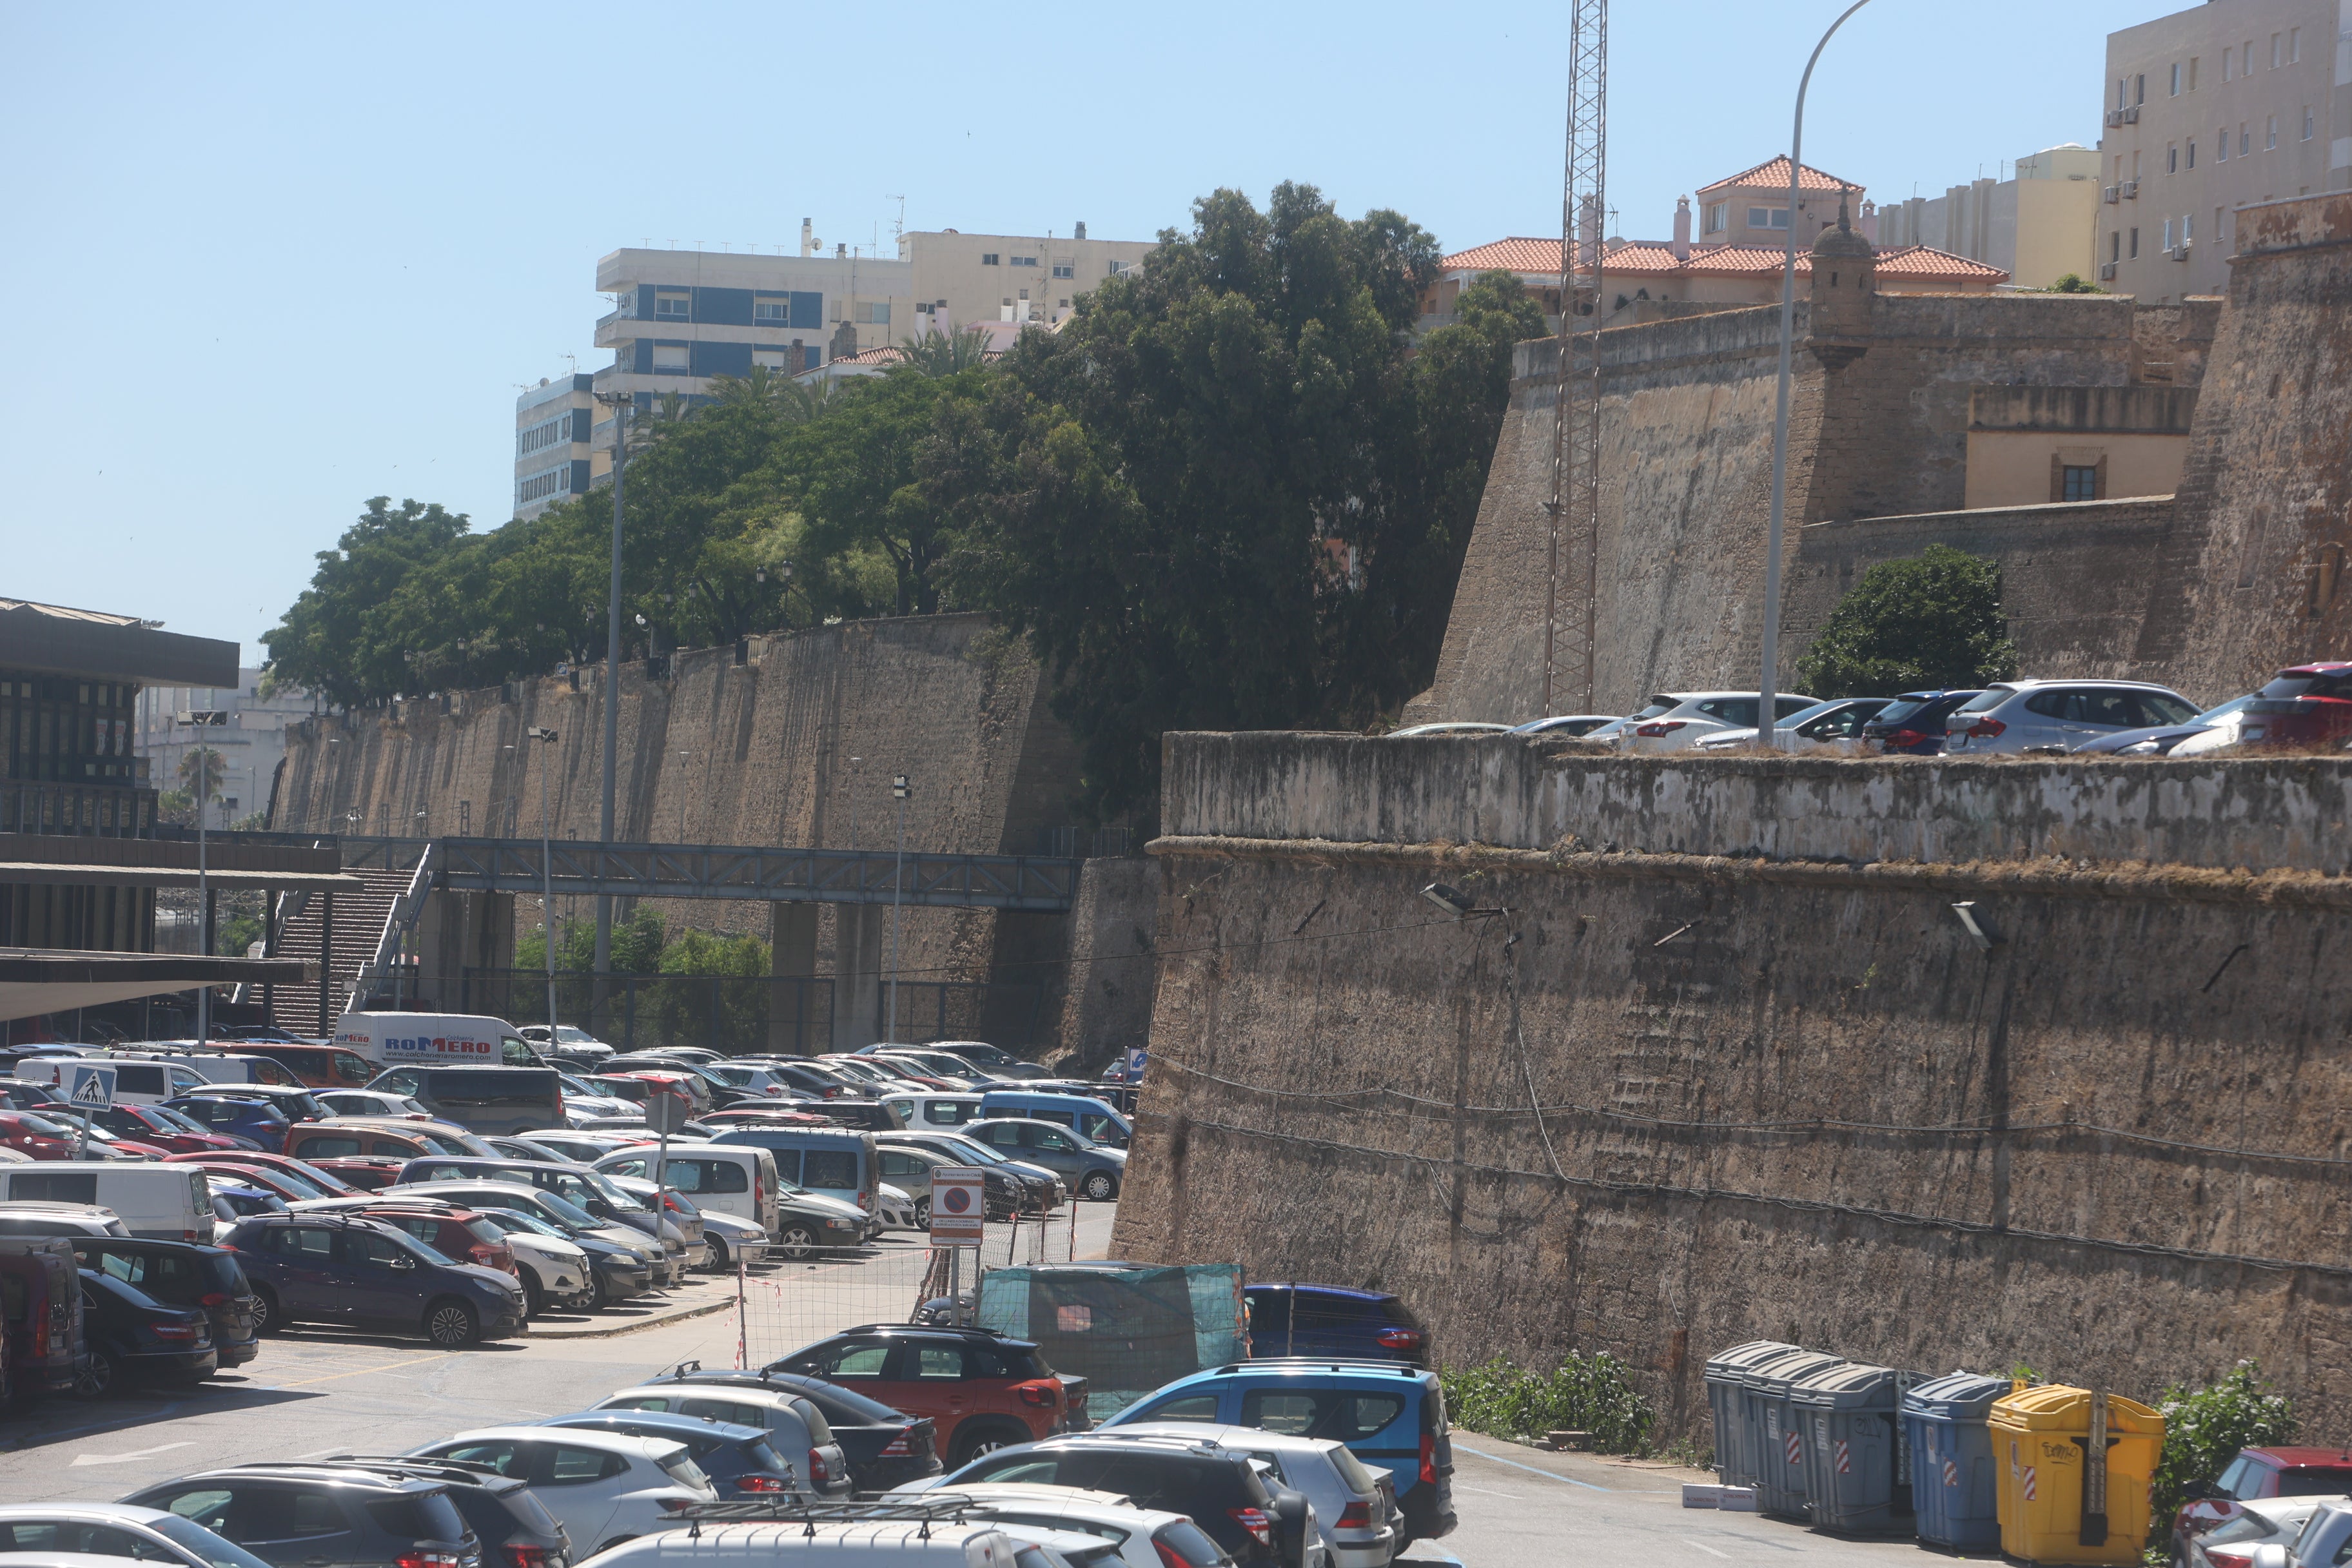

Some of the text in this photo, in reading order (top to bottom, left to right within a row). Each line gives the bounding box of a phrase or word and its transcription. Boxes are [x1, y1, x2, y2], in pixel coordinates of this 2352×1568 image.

[335, 1034, 369, 1043] ROMERO
[386, 1037, 491, 1054] ROMERO
[386, 1051, 491, 1060] www.colchoneriaromero.com
